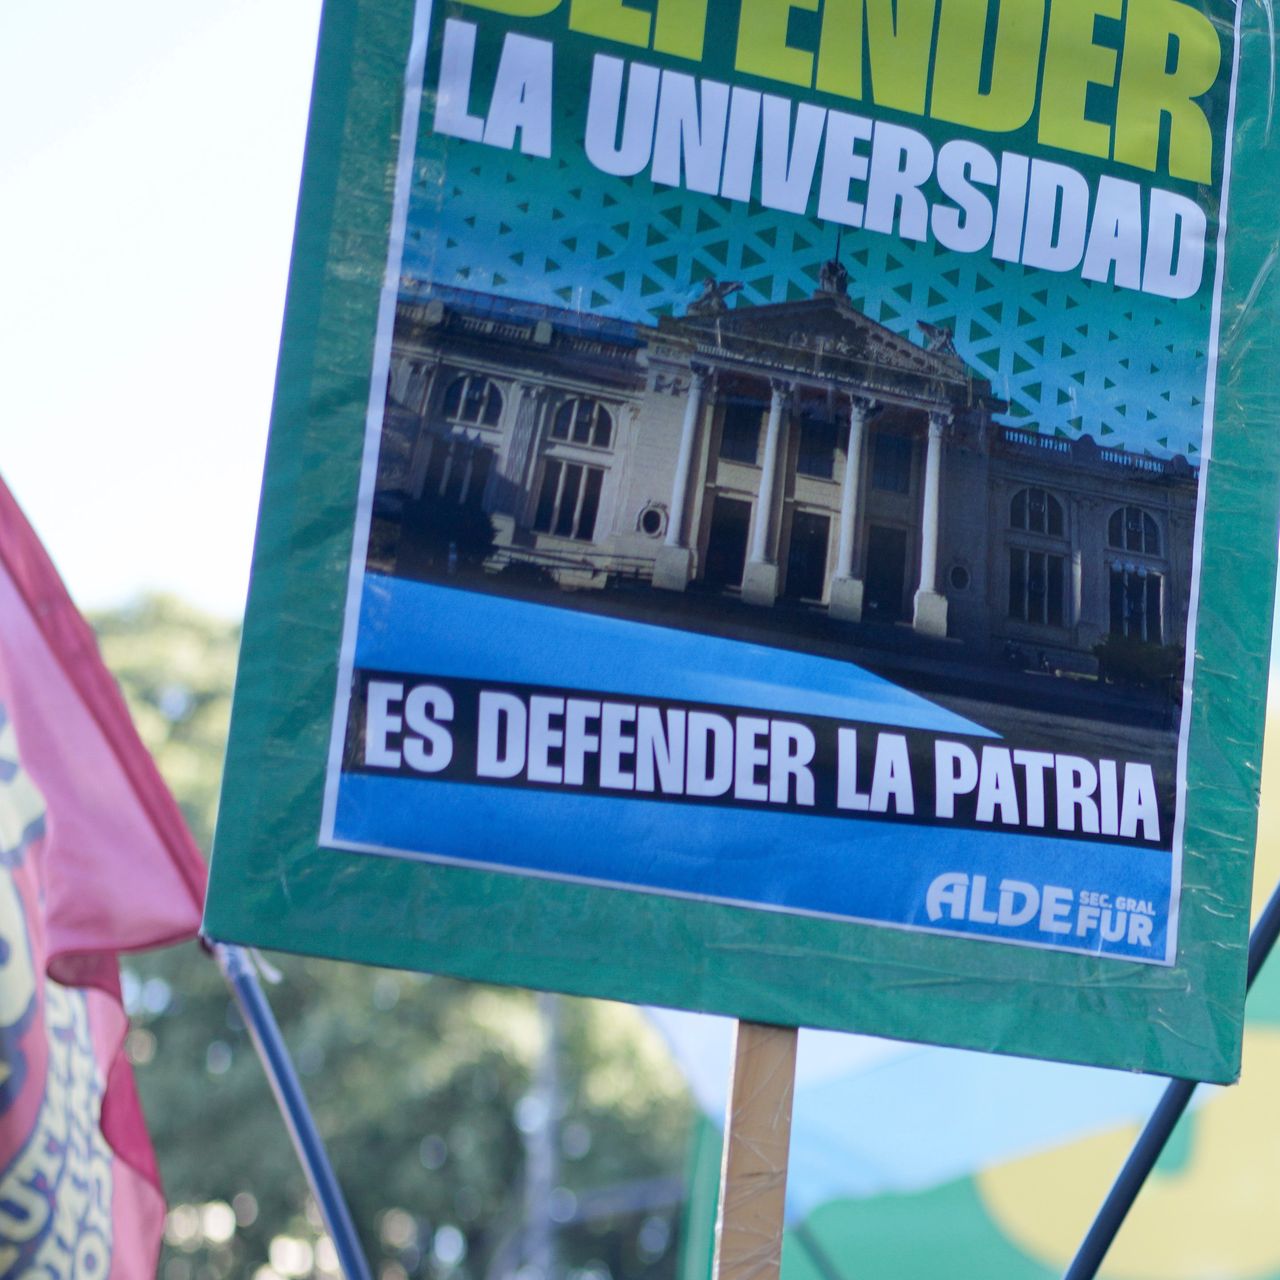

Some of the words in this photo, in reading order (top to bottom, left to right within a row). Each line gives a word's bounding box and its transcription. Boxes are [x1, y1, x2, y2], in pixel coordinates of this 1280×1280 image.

[433, 17, 554, 160] LA
[584, 52, 1206, 301] UNIVERSIDAD
[365, 680, 454, 774] ES
[477, 689, 815, 807] DEFENDER
[835, 728, 916, 816] LA
[934, 741, 1162, 843] PATRIA
[926, 872, 1074, 935] ALDE
[1079, 889, 1113, 909] SEC.
[1115, 895, 1157, 916] GRAL
[1076, 905, 1154, 947] FUR
